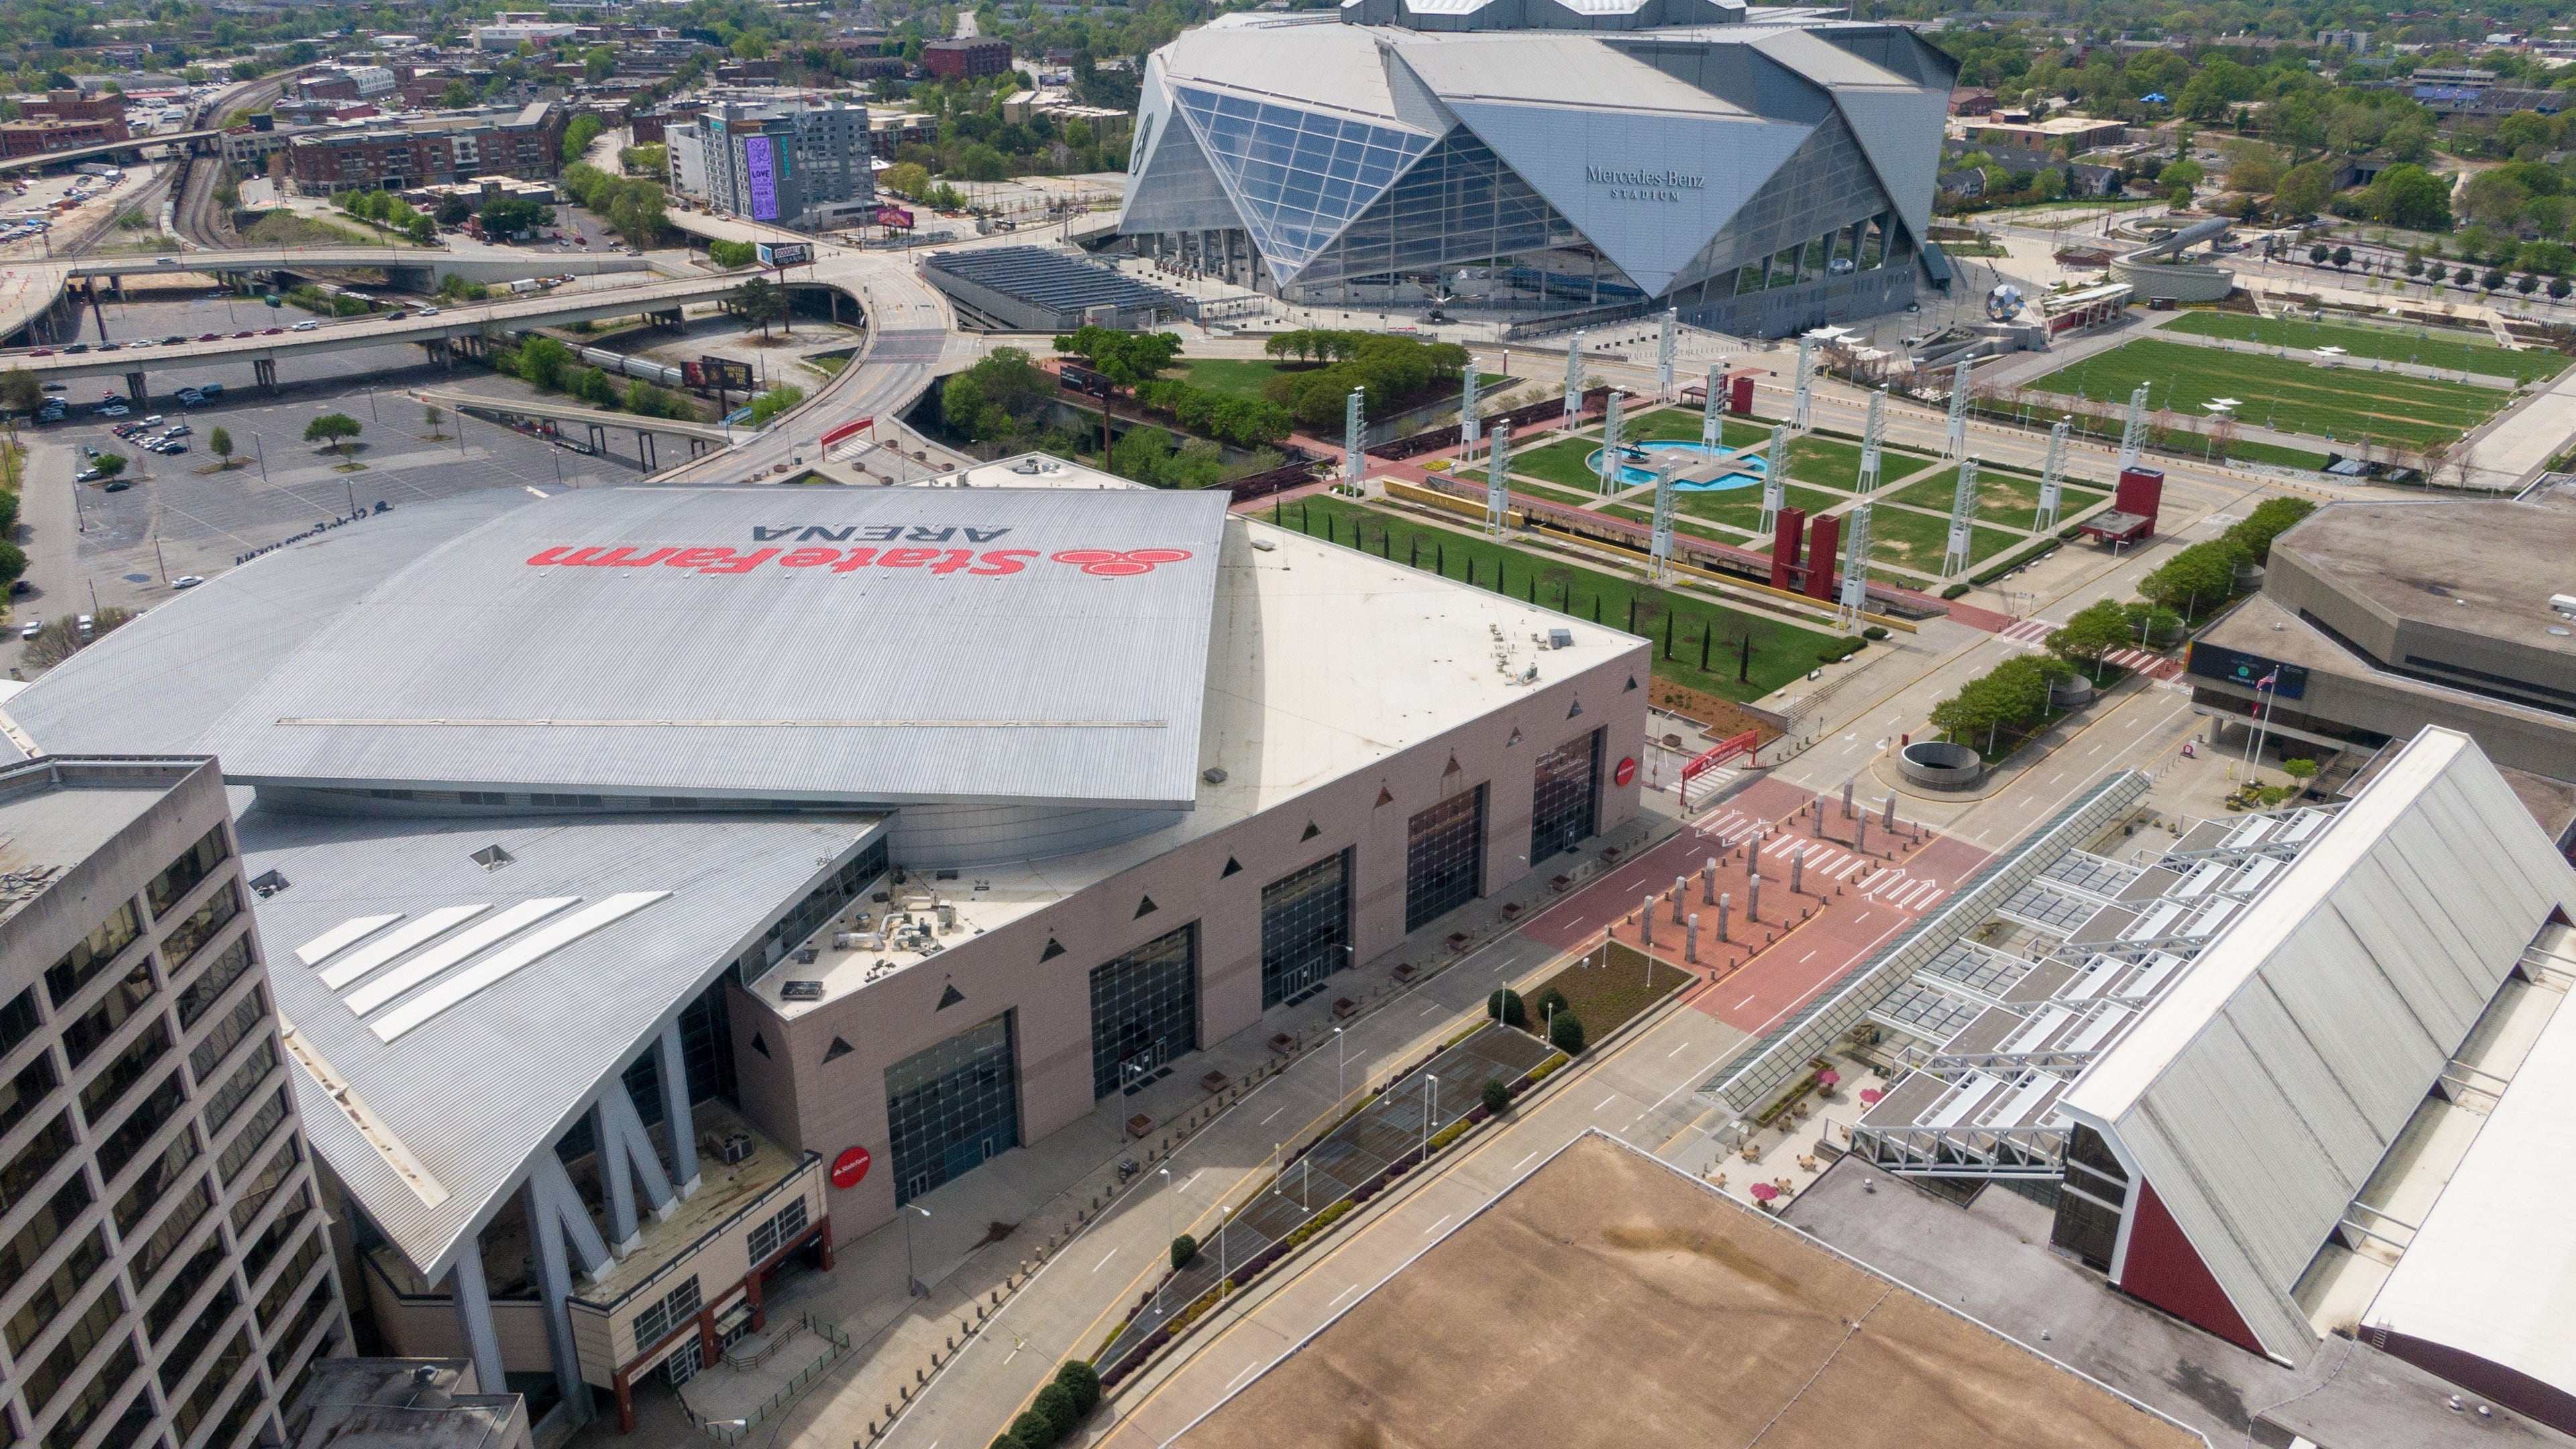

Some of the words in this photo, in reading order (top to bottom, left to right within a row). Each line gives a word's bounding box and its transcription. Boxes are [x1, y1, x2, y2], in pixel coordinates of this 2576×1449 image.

[781, 136, 790, 176] REVERB
[751, 170, 770, 178] LOVE
[1587, 166, 1705, 188] Mercedes-Benz
[1611, 188, 1680, 201] STADIUM
[753, 525, 1014, 543] ARENA
